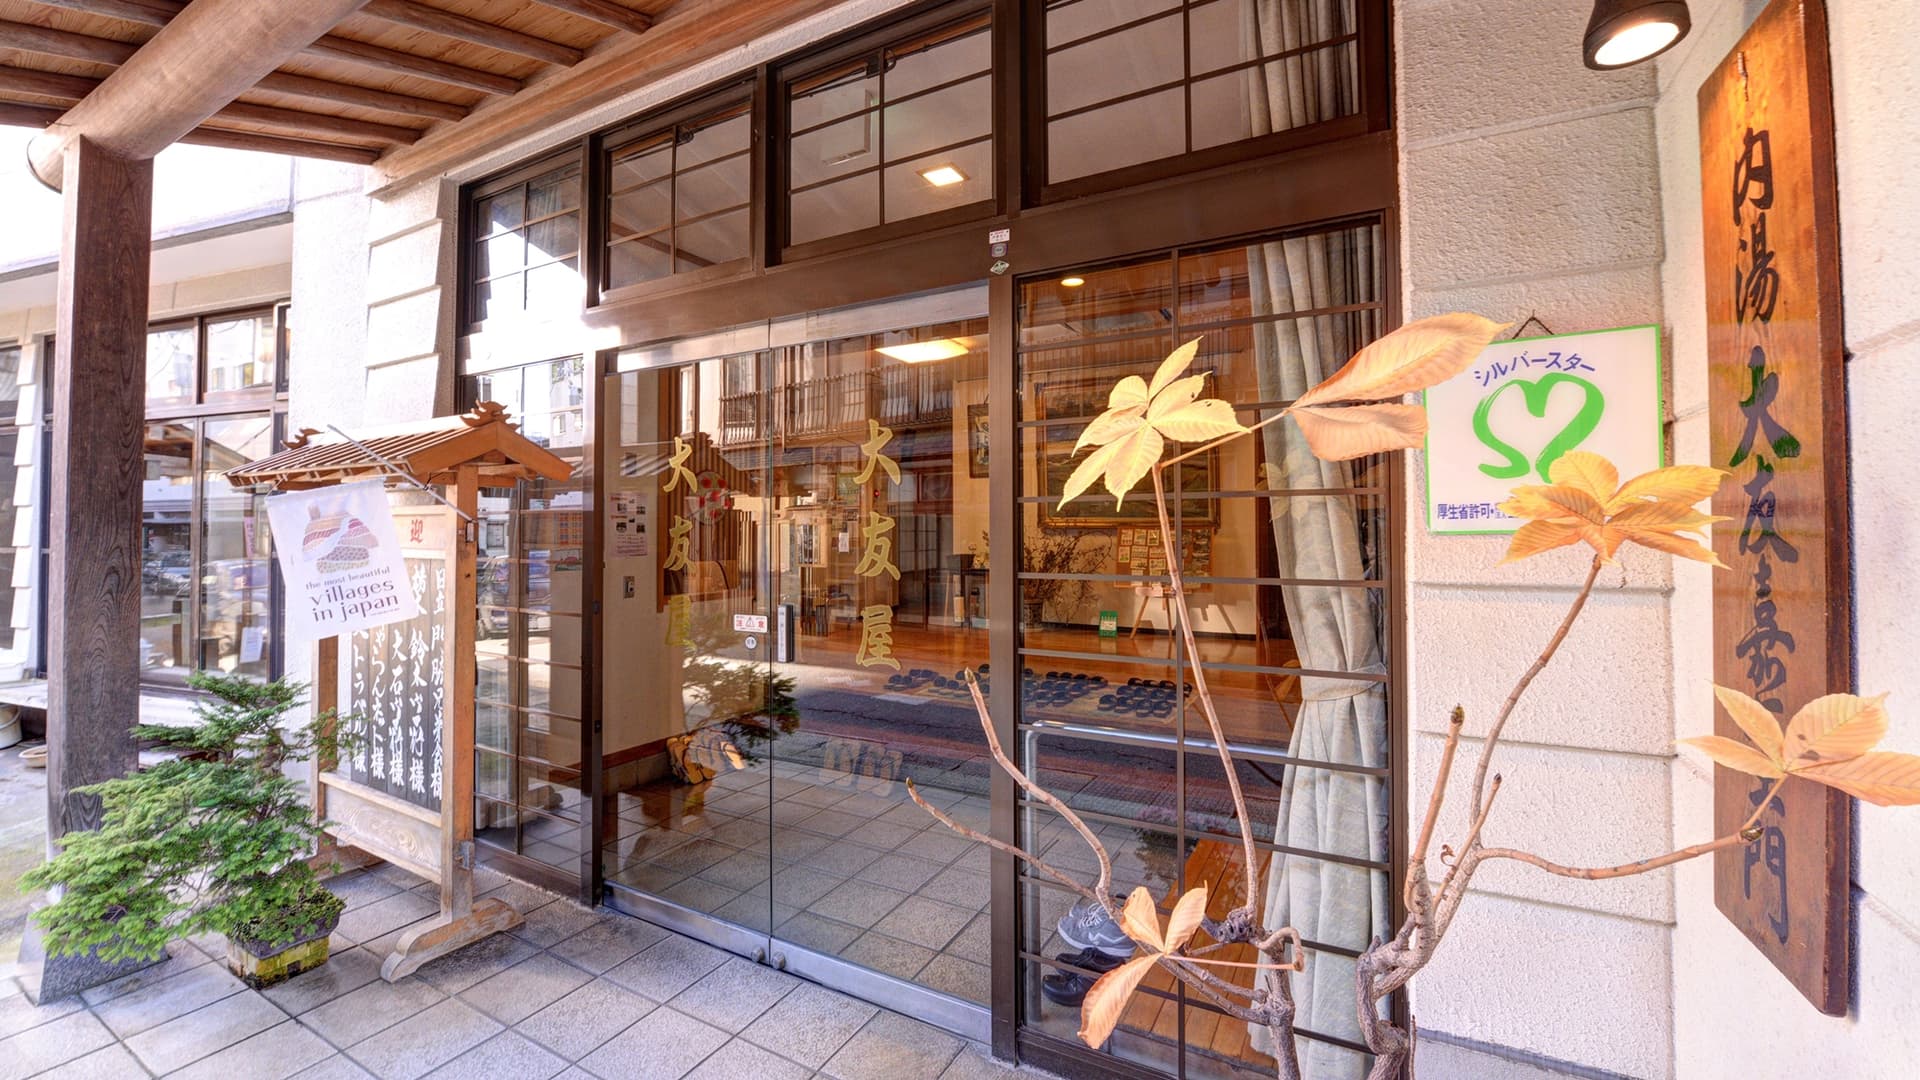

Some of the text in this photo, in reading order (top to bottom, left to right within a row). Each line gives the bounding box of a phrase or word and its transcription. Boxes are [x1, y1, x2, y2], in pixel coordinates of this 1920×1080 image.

[1474, 351, 1596, 387] シルバースター
[662, 436, 698, 649] 大友屋
[853, 418, 902, 671] 大友屋
[306, 566, 391, 592] the most beautiful
[310, 579, 395, 606] villages
[312, 606, 333, 623] in
[340, 594, 399, 622] japan
